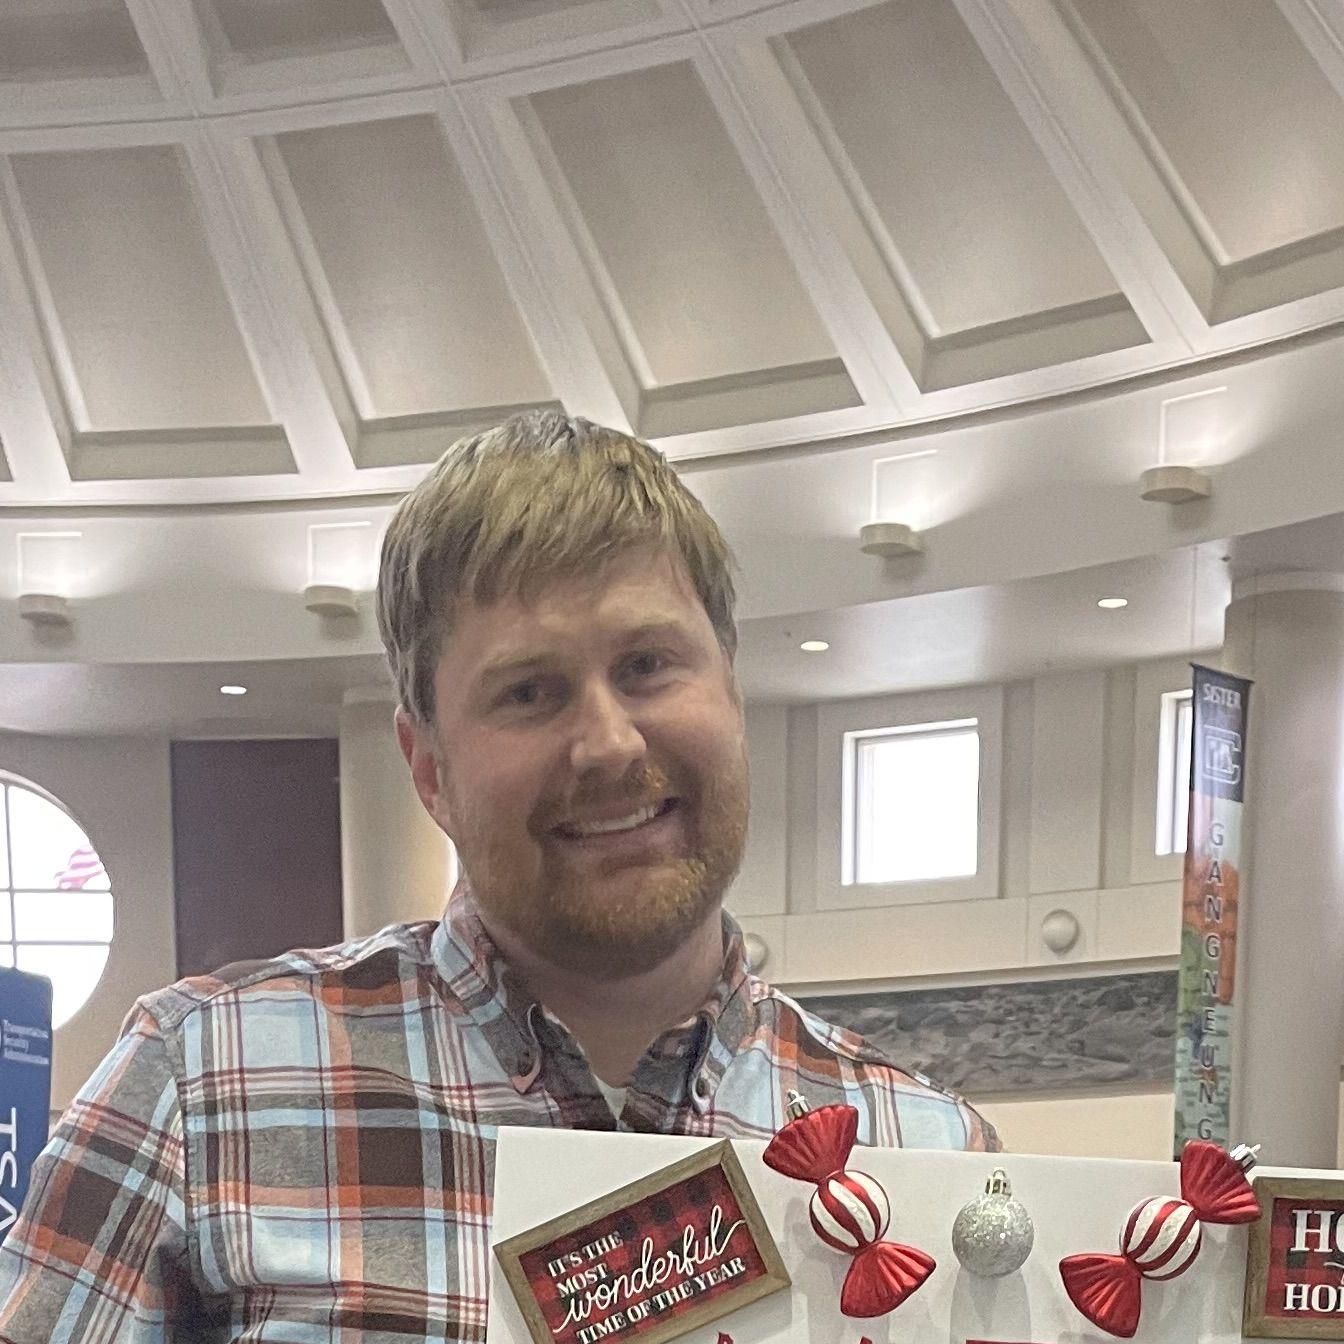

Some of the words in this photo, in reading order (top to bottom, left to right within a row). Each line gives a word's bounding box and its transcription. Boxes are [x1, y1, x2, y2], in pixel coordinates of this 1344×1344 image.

[1203, 683, 1241, 709] SISTER
[1196, 823, 1225, 1142] GANGNEUNG
[548, 1251, 583, 1277] IT'S
[582, 1230, 624, 1260] THE
[553, 1204, 747, 1334] wonderful
[556, 1262, 608, 1299] MOST
[627, 1299, 652, 1323] OF
[652, 1280, 694, 1312] THE
[692, 1256, 746, 1292] YEAR
